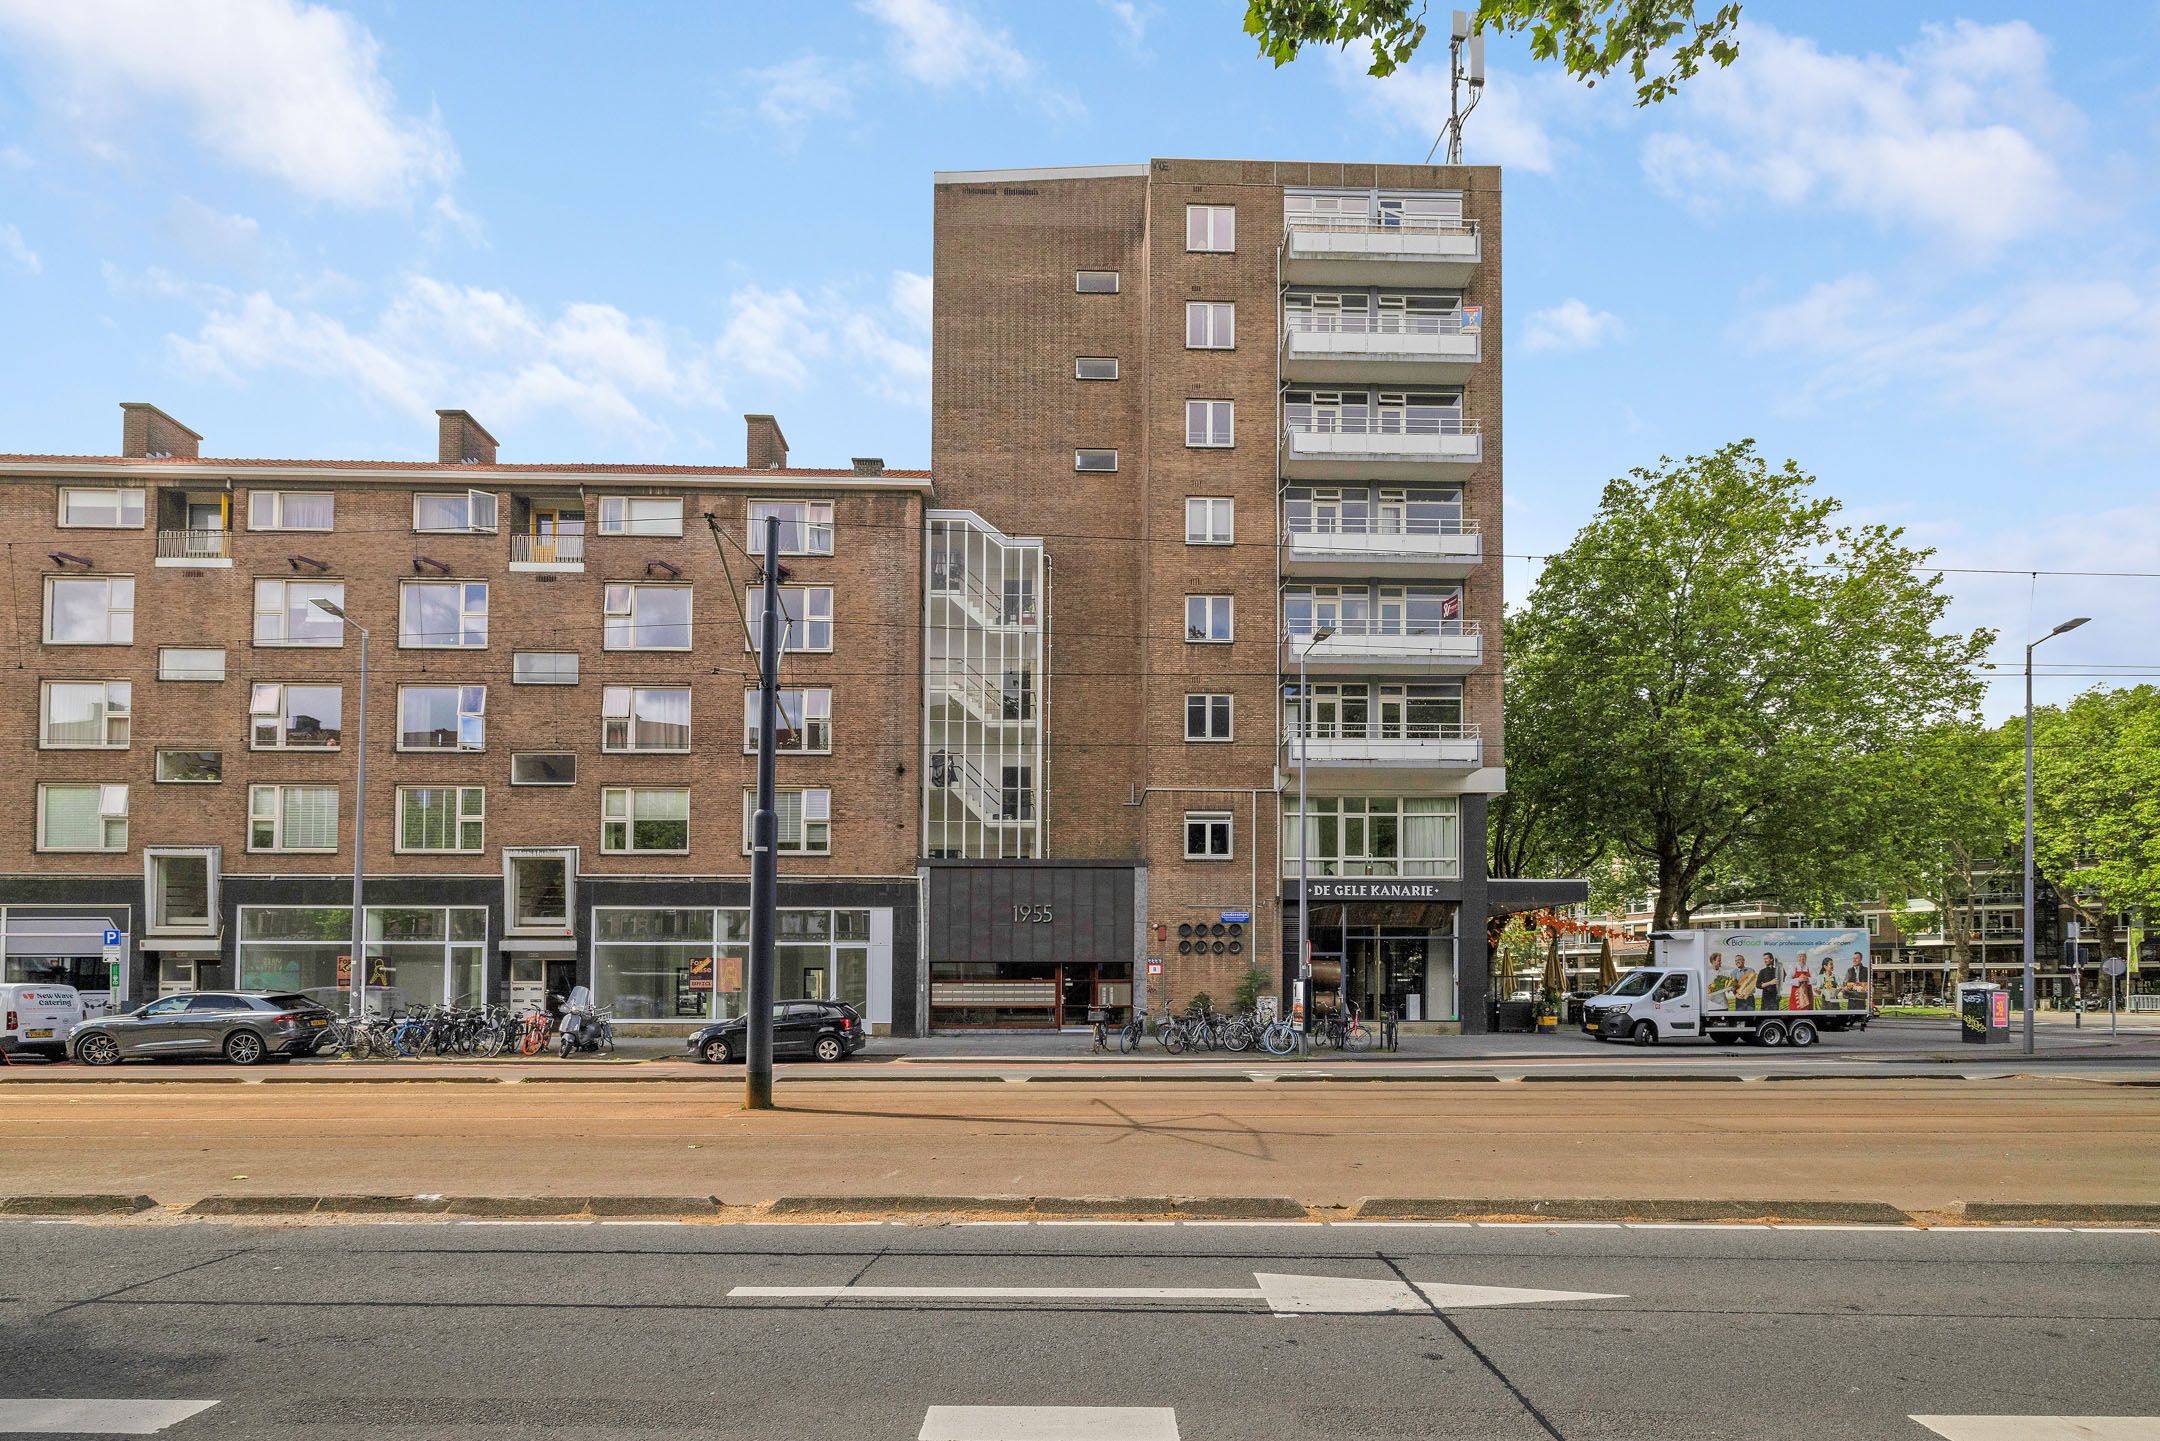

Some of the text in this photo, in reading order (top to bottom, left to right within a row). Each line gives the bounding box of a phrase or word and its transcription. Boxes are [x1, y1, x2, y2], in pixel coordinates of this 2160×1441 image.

[1314, 885, 1434, 897] DE GELE KANARIE
[1013, 904, 1053, 922] 1955
[106, 931, 117, 944] P
[38, 999, 72, 1007] Catering
